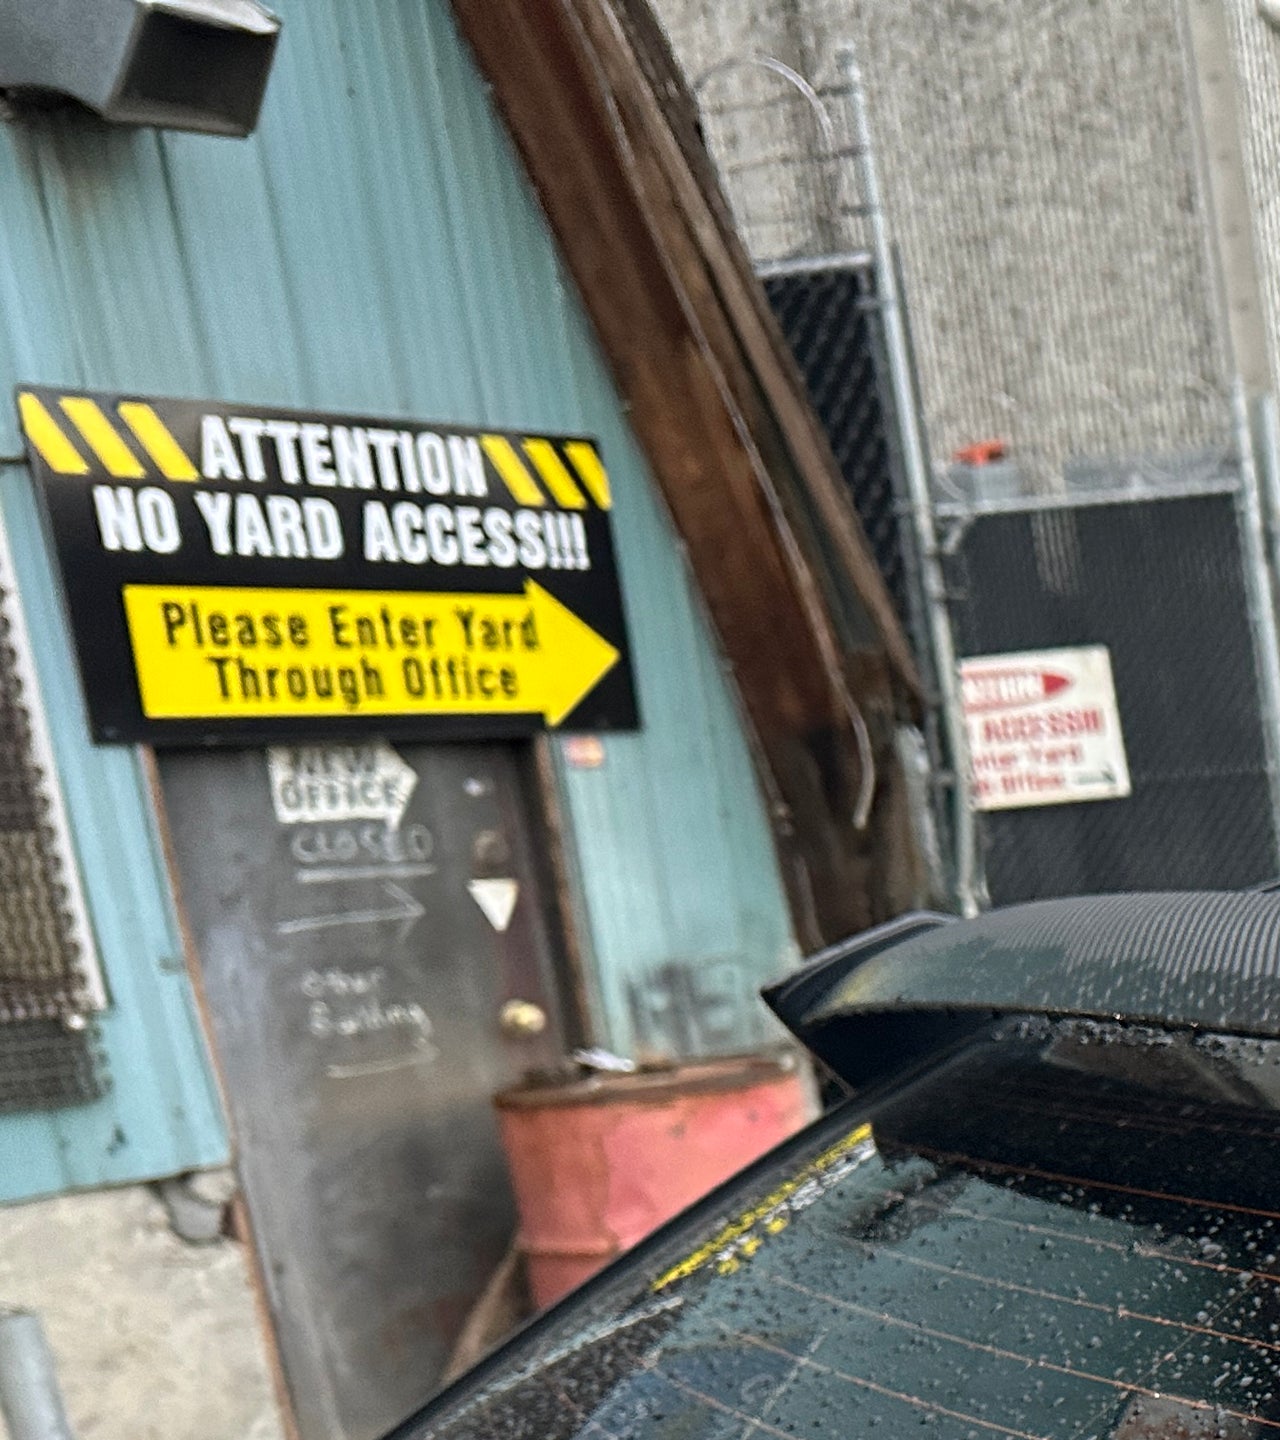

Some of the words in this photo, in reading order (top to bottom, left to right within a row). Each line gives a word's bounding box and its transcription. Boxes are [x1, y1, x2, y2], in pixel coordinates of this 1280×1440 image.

[199, 412, 490, 499] ATTENTION
[93, 484, 182, 554] NO
[194, 490, 344, 561] YARD
[362, 499, 594, 573] ACCESS!!!
[161, 599, 308, 649] Please
[330, 604, 437, 651] Enter
[455, 606, 542, 653] Yard
[207, 655, 386, 711] Through
[401, 656, 519, 701] Office
